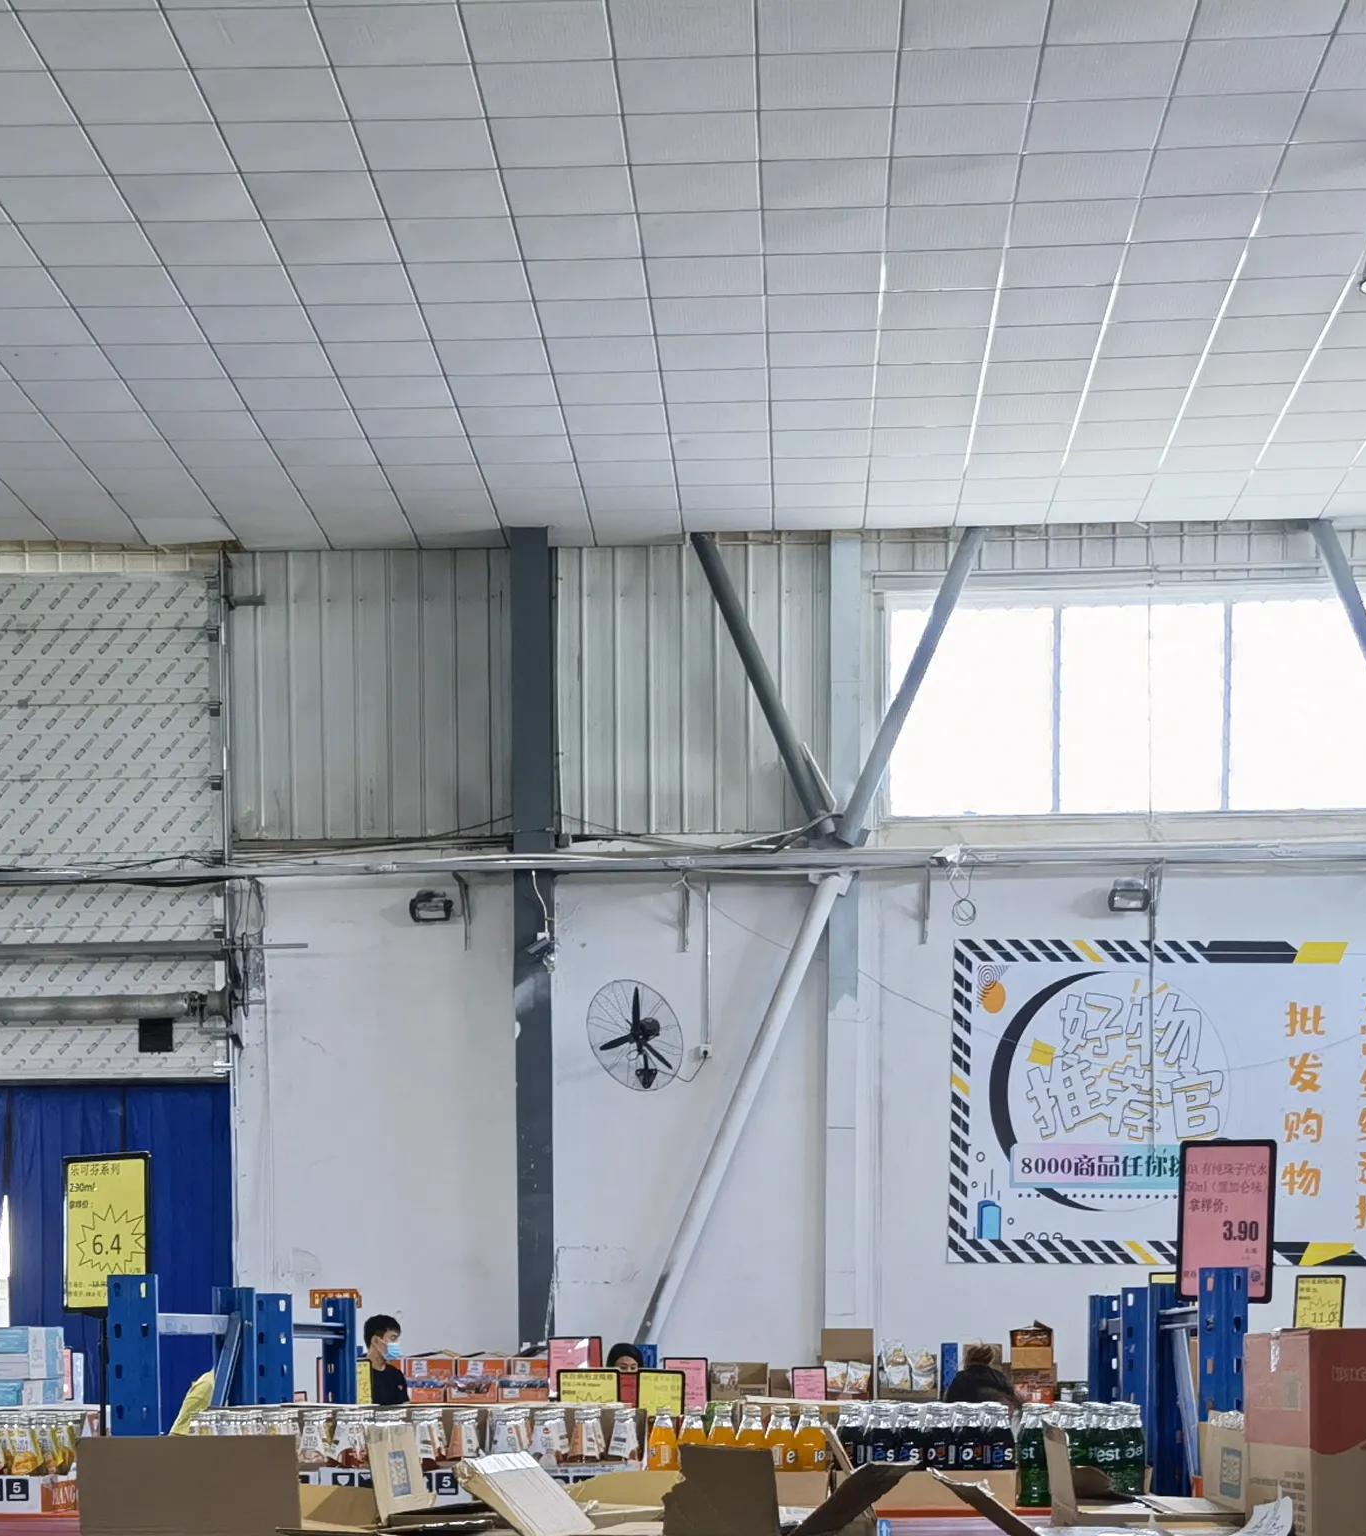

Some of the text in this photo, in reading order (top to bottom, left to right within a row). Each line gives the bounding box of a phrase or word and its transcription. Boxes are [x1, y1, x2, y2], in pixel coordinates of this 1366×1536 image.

[1060, 991, 1202, 1070] 好物
[1025, 1054, 1224, 1141] 推荐官
[1280, 1000, 1326, 1199] 批发购物
[92, 1233, 122, 1256] 6.4
[1222, 1220, 1259, 1242] 3.90
